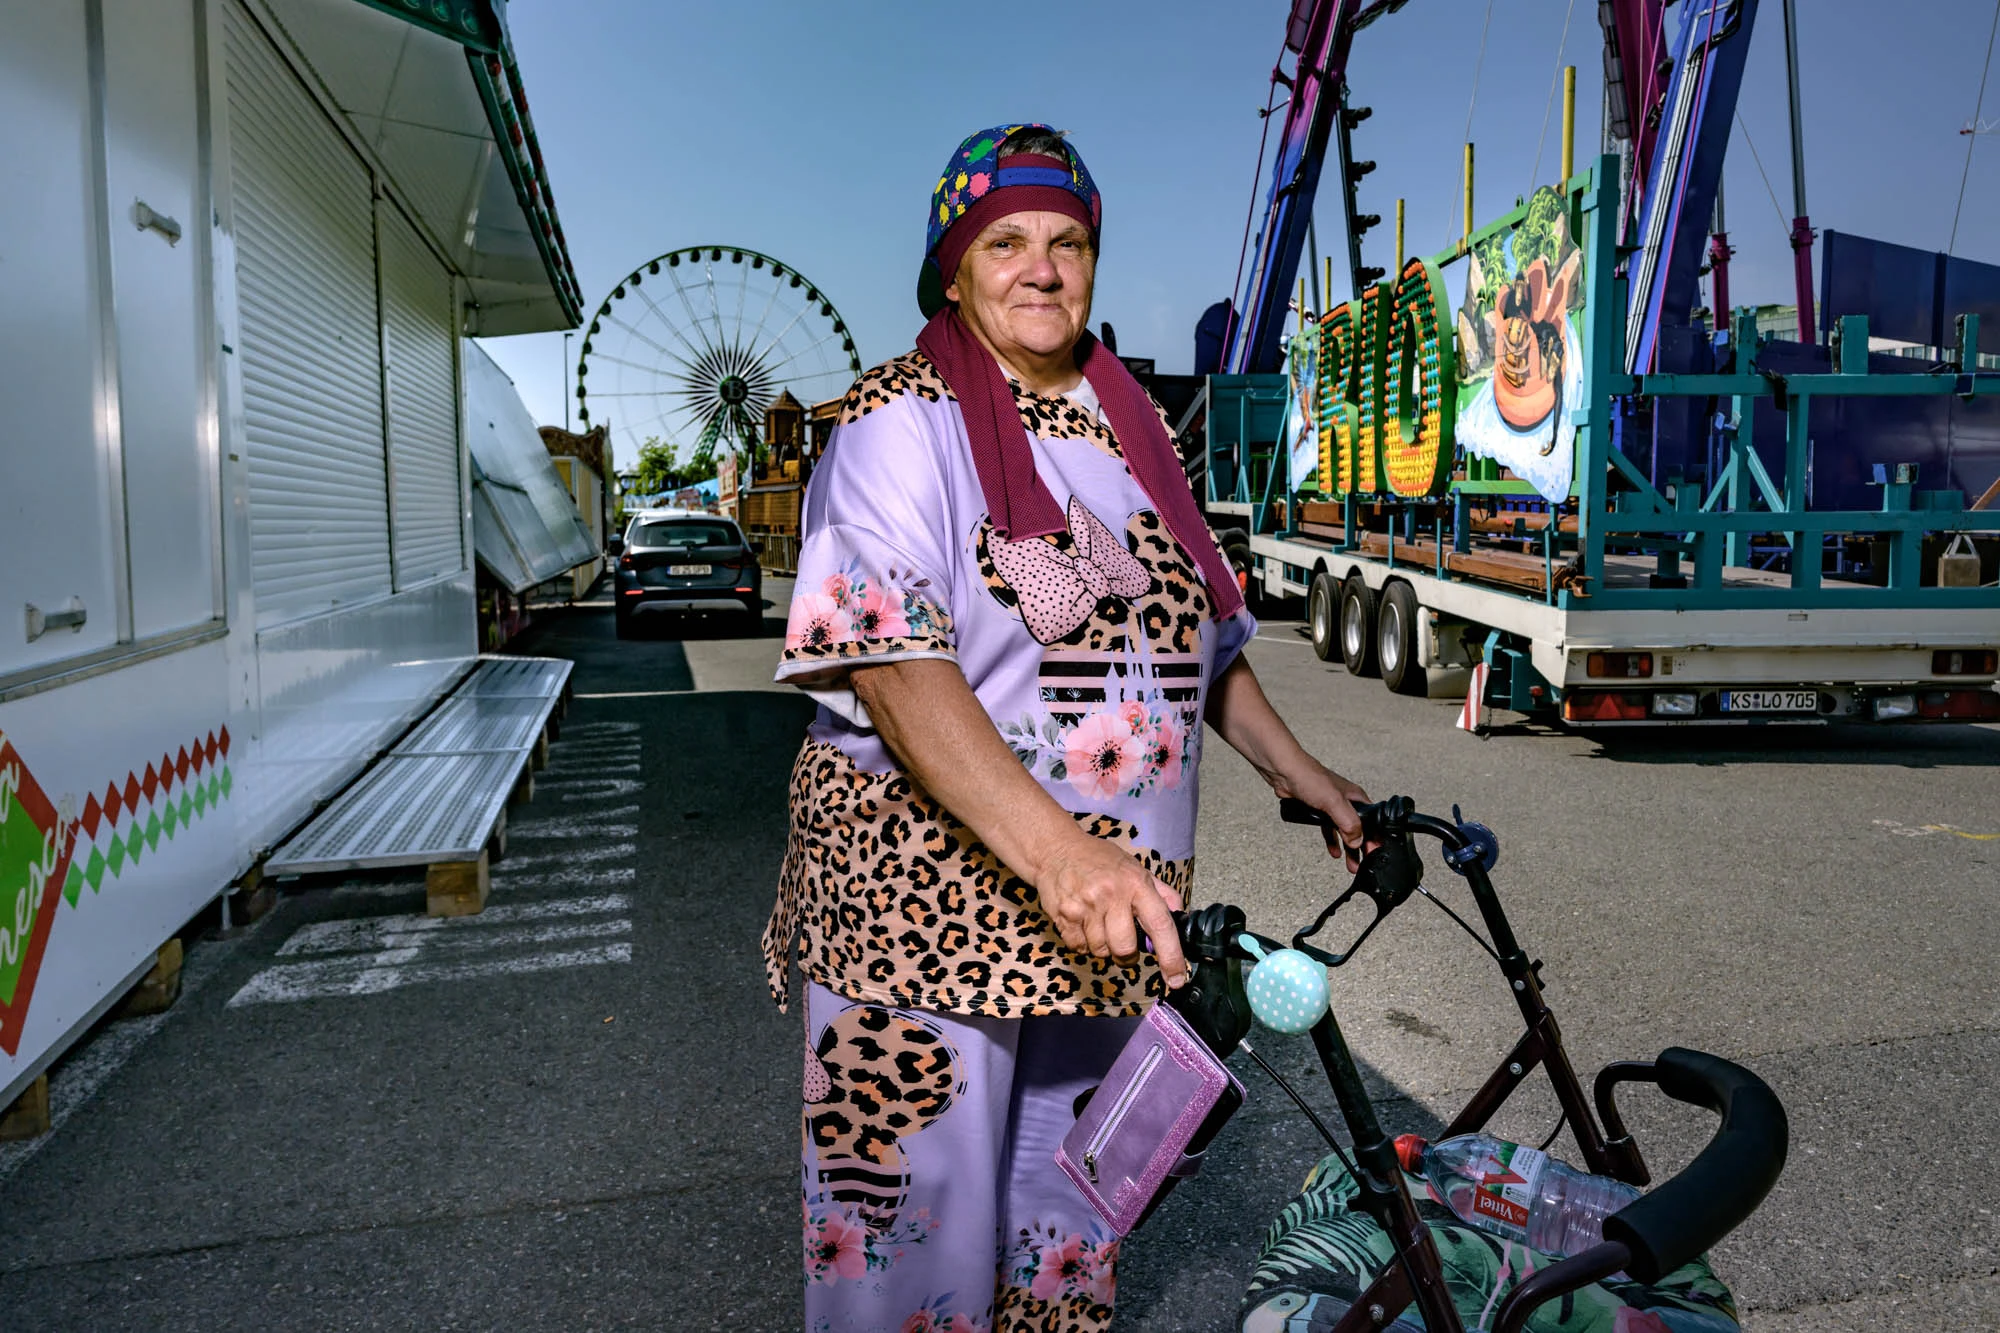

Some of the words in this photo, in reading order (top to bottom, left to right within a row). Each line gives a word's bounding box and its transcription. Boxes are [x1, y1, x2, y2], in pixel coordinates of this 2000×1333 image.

[1318, 257, 1454, 497] RIO
[725, 381, 743, 399] B
[1731, 693, 1751, 709] KS
[1762, 693, 1782, 709] LO
[1786, 693, 1815, 709] 705
[1479, 1196, 1513, 1220] Vittel
